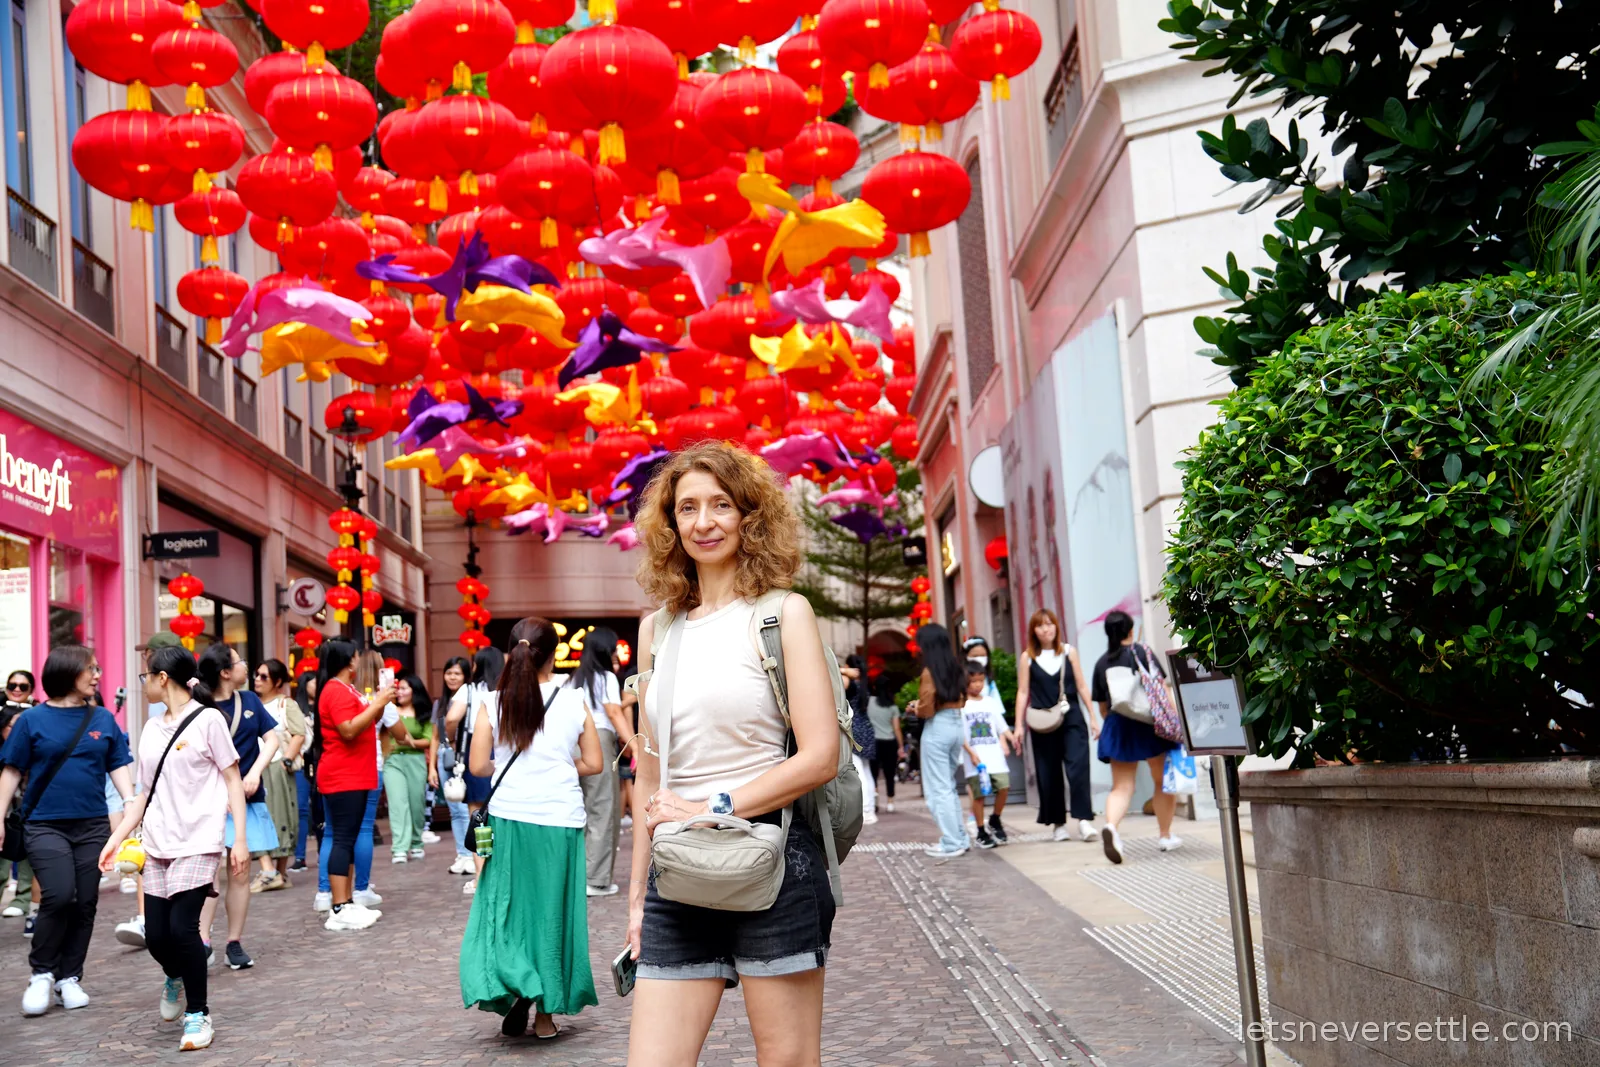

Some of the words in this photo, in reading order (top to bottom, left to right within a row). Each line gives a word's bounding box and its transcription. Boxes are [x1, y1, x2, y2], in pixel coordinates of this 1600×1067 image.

[0, 433, 73, 516] benefit
[163, 536, 208, 552] logitech
[1219, 701, 1230, 710] Floor
